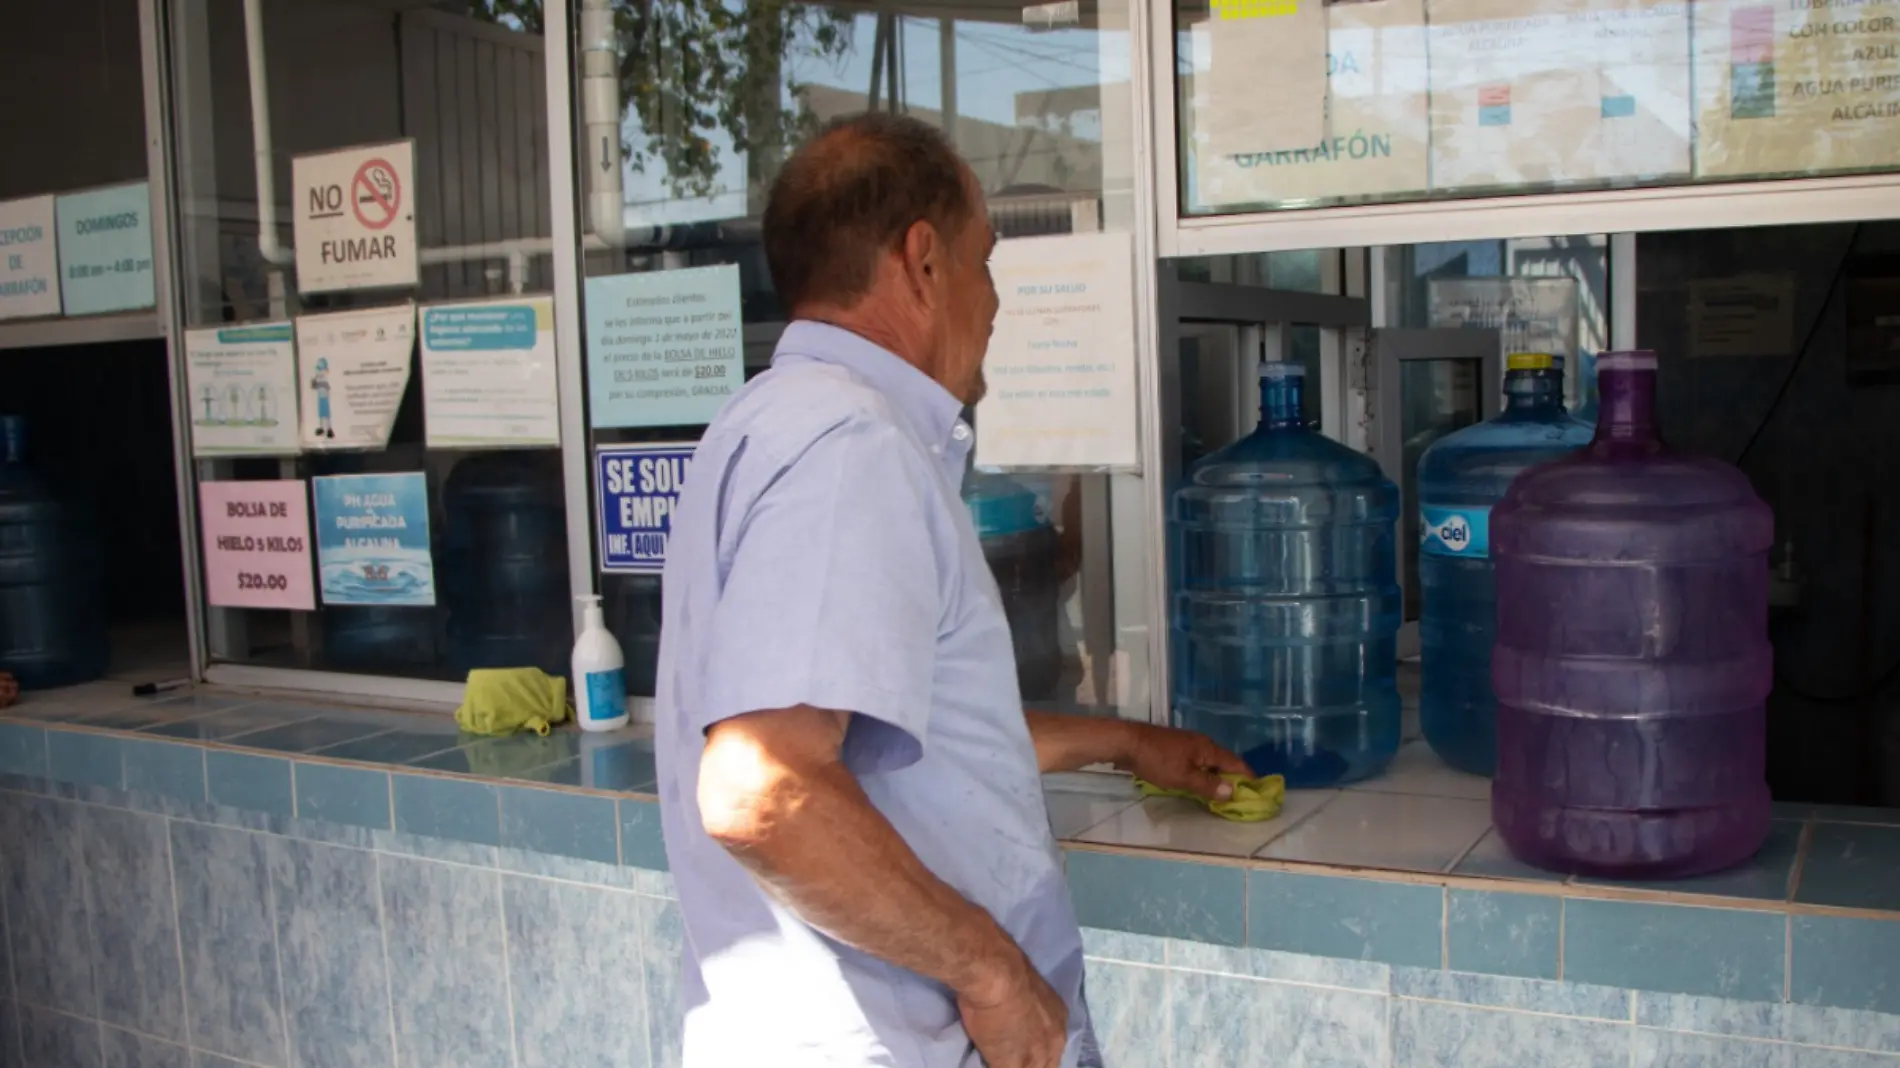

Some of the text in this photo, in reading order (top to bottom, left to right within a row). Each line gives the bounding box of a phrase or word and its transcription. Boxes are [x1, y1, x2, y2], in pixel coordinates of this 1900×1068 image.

[1832, 17, 1894, 34] COLOR
[1853, 46, 1899, 61] AZUL
[310, 184, 342, 212] NO
[76, 212, 138, 235] DOMINGOS
[321, 235, 396, 264] FUMAR
[1055, 283, 1086, 293] SALUD
[665, 349, 692, 362] BOLSA
[694, 365, 726, 378] $20.00
[606, 459, 635, 493] SE
[227, 502, 287, 517] BOLSA DE
[1441, 522, 1466, 541] ciel
[217, 536, 253, 551] HIELO
[268, 537, 303, 552] KILOS
[609, 534, 631, 555] INF.
[237, 573, 287, 590] $20.00
